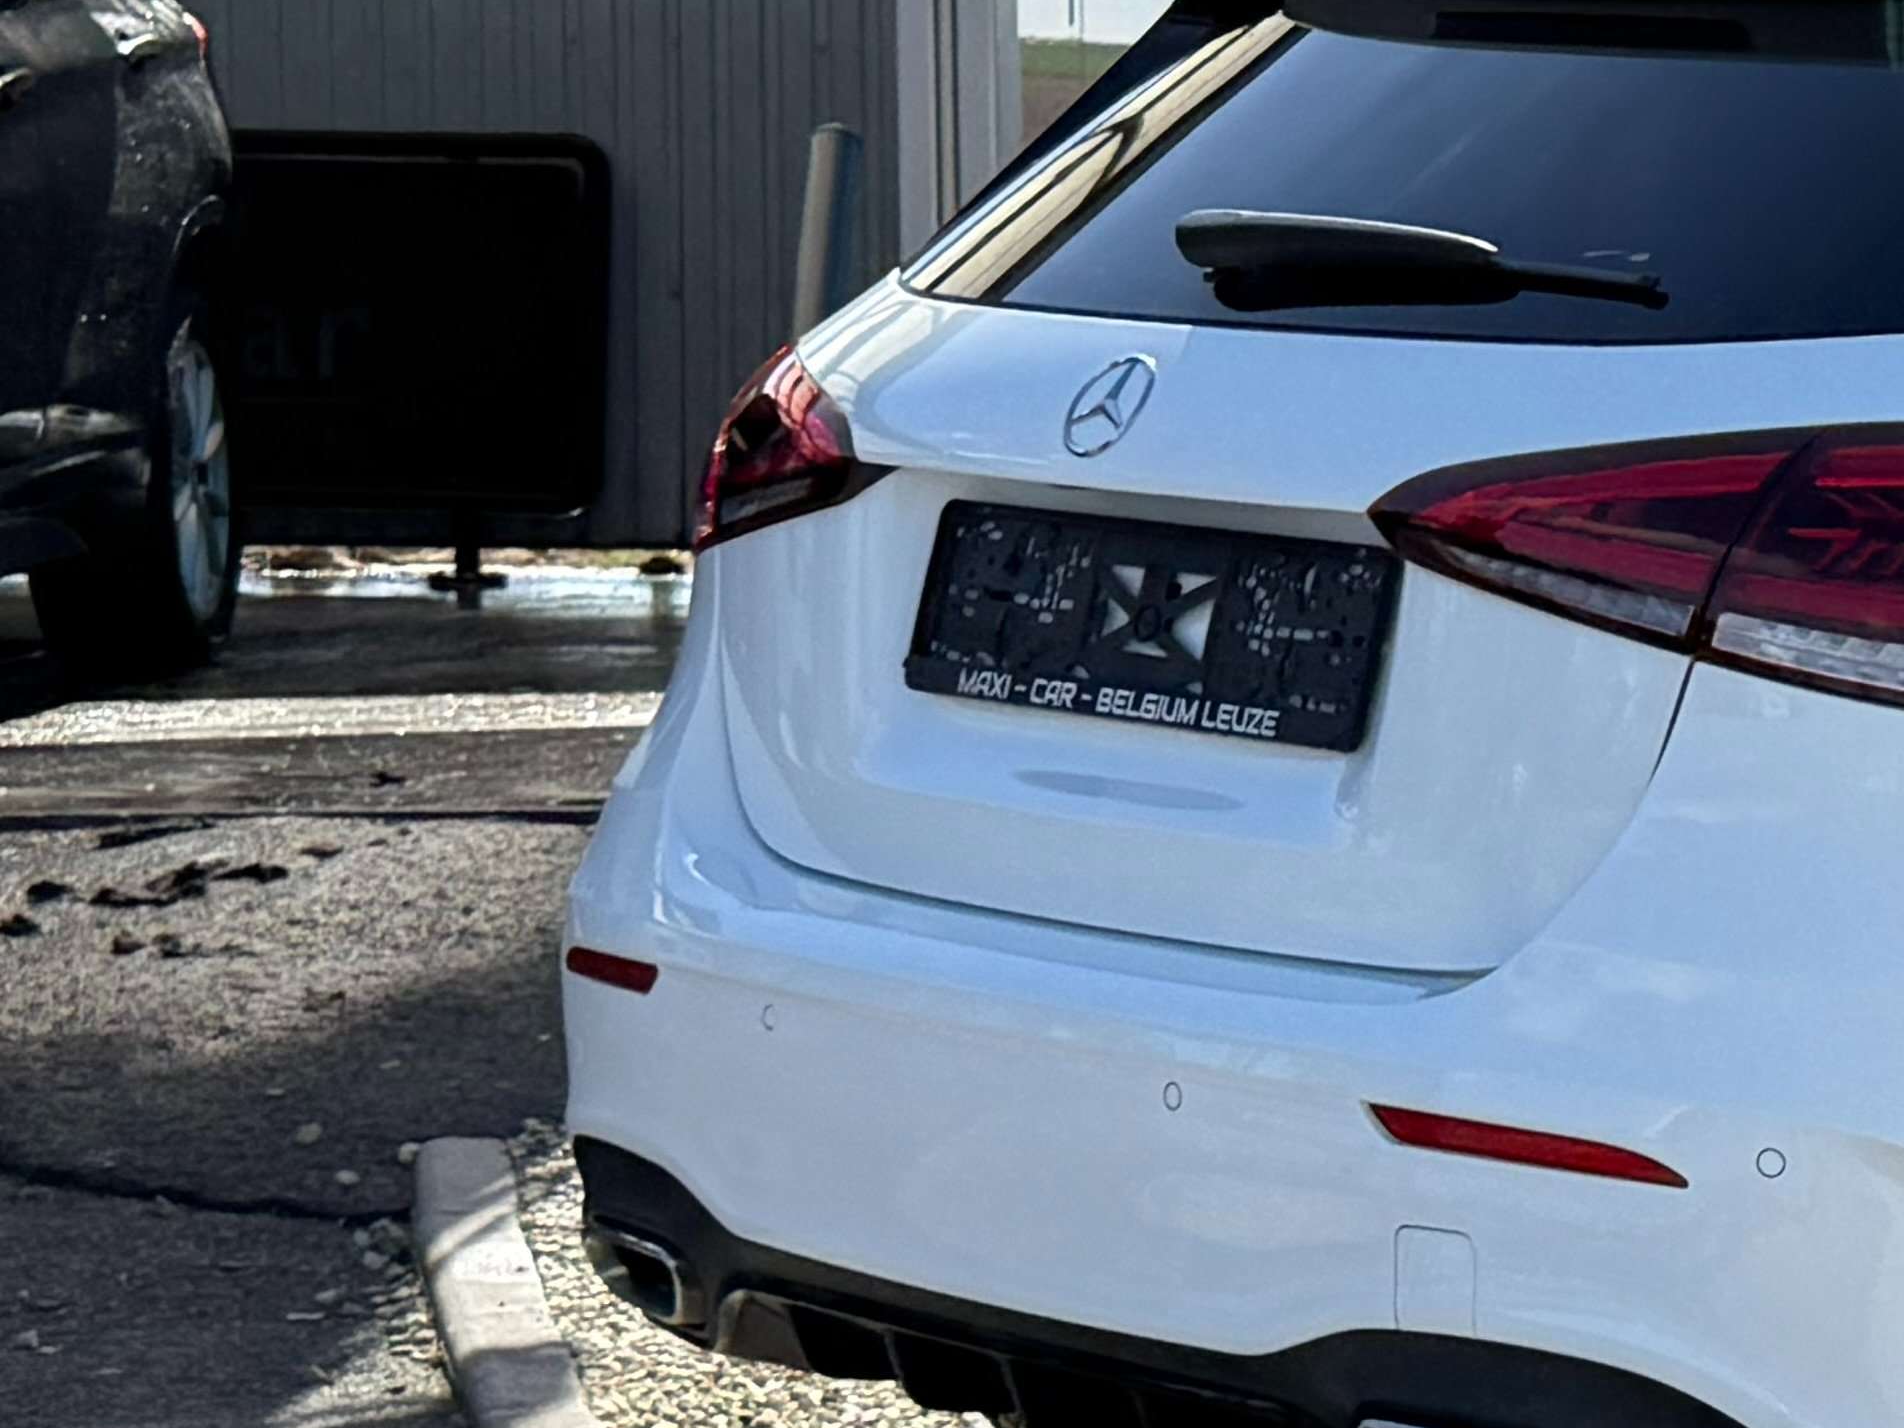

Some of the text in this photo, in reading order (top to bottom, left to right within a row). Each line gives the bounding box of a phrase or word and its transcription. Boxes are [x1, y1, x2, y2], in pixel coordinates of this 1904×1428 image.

[957, 668, 1011, 700] MAXI
[1029, 677, 1077, 708] CAR
[1095, 687, 1199, 725] BELGIUM
[1201, 700, 1280, 737] LEUZE
